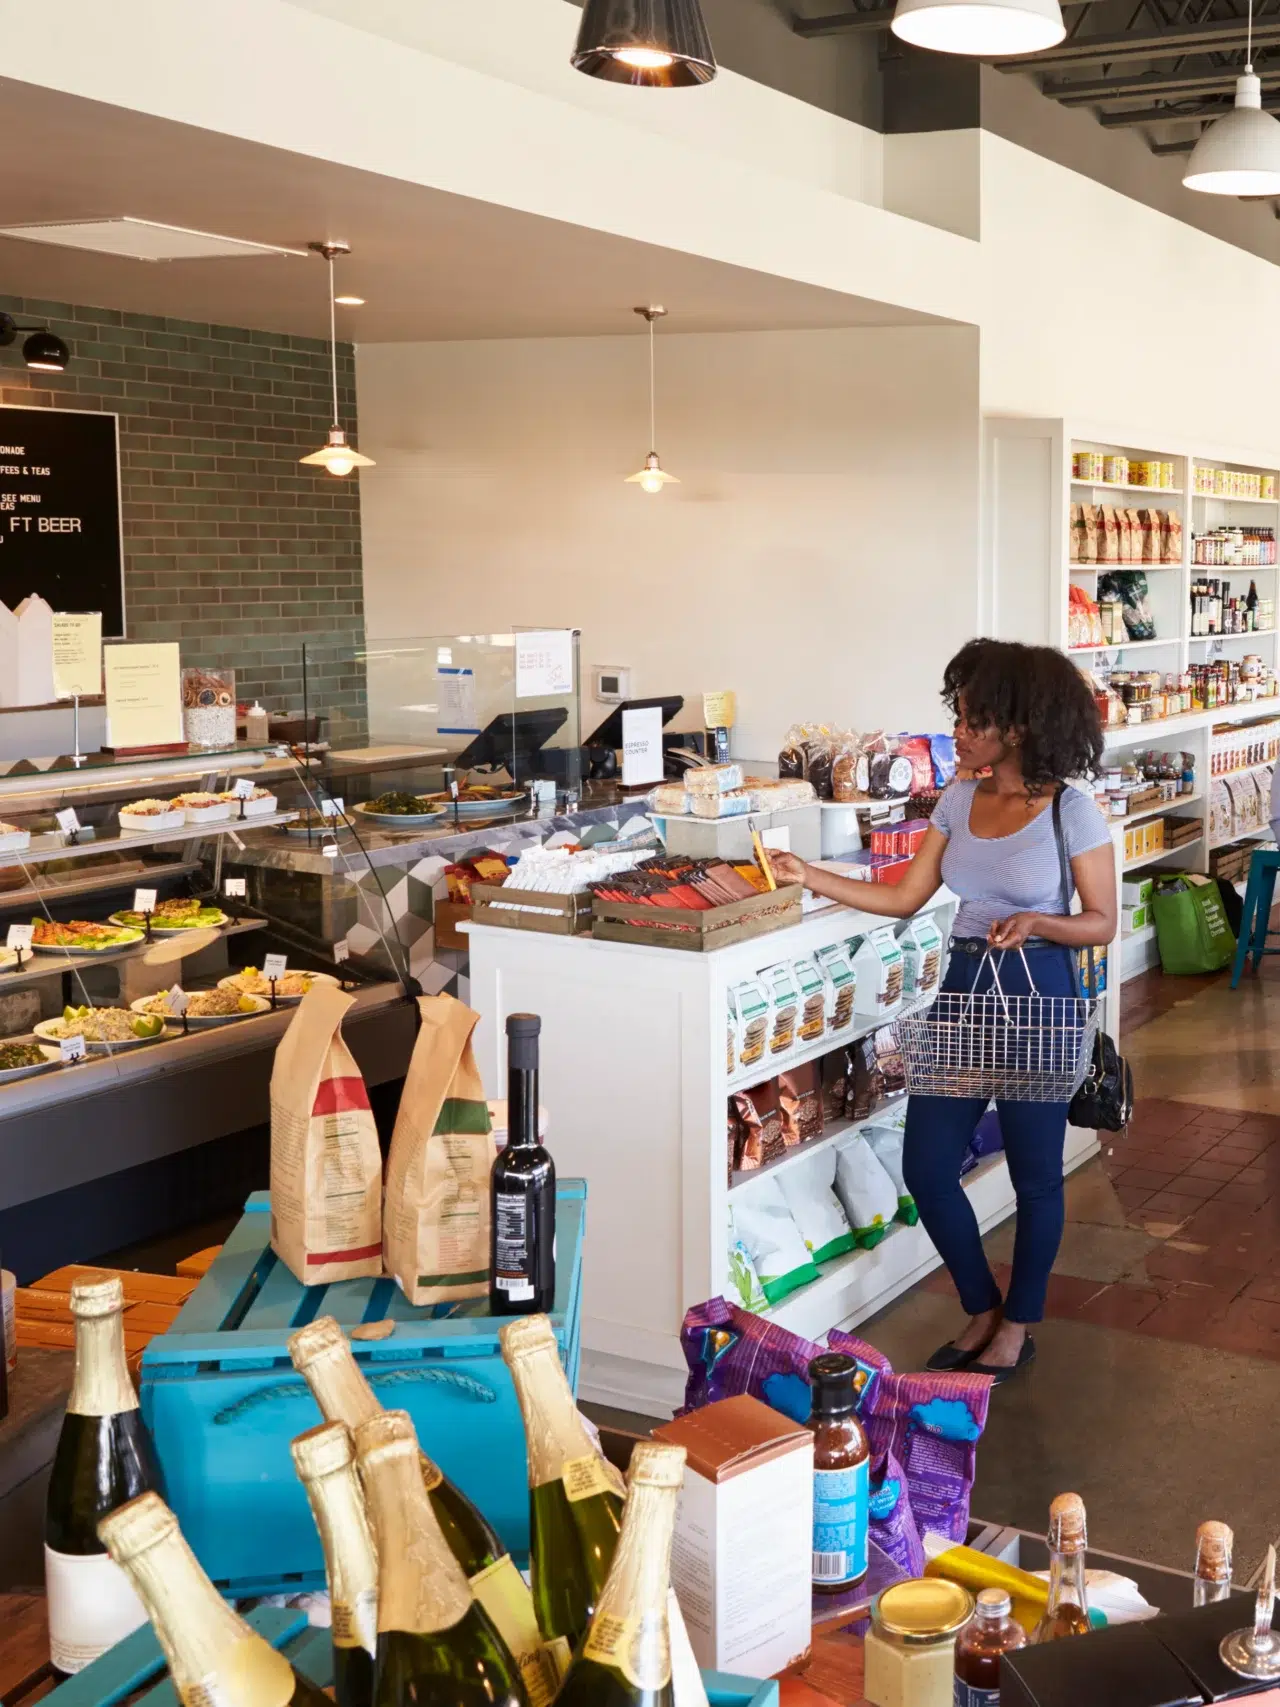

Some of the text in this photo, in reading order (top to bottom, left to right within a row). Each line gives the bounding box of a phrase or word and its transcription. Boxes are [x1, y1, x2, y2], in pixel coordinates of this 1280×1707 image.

[31, 467, 51, 476] TEAS
[1, 494, 41, 503] SEE MENU
[38, 517, 82, 532] BEER
[625, 741, 649, 749] ESPRESSO
[625, 748, 648, 756] COUNTER
